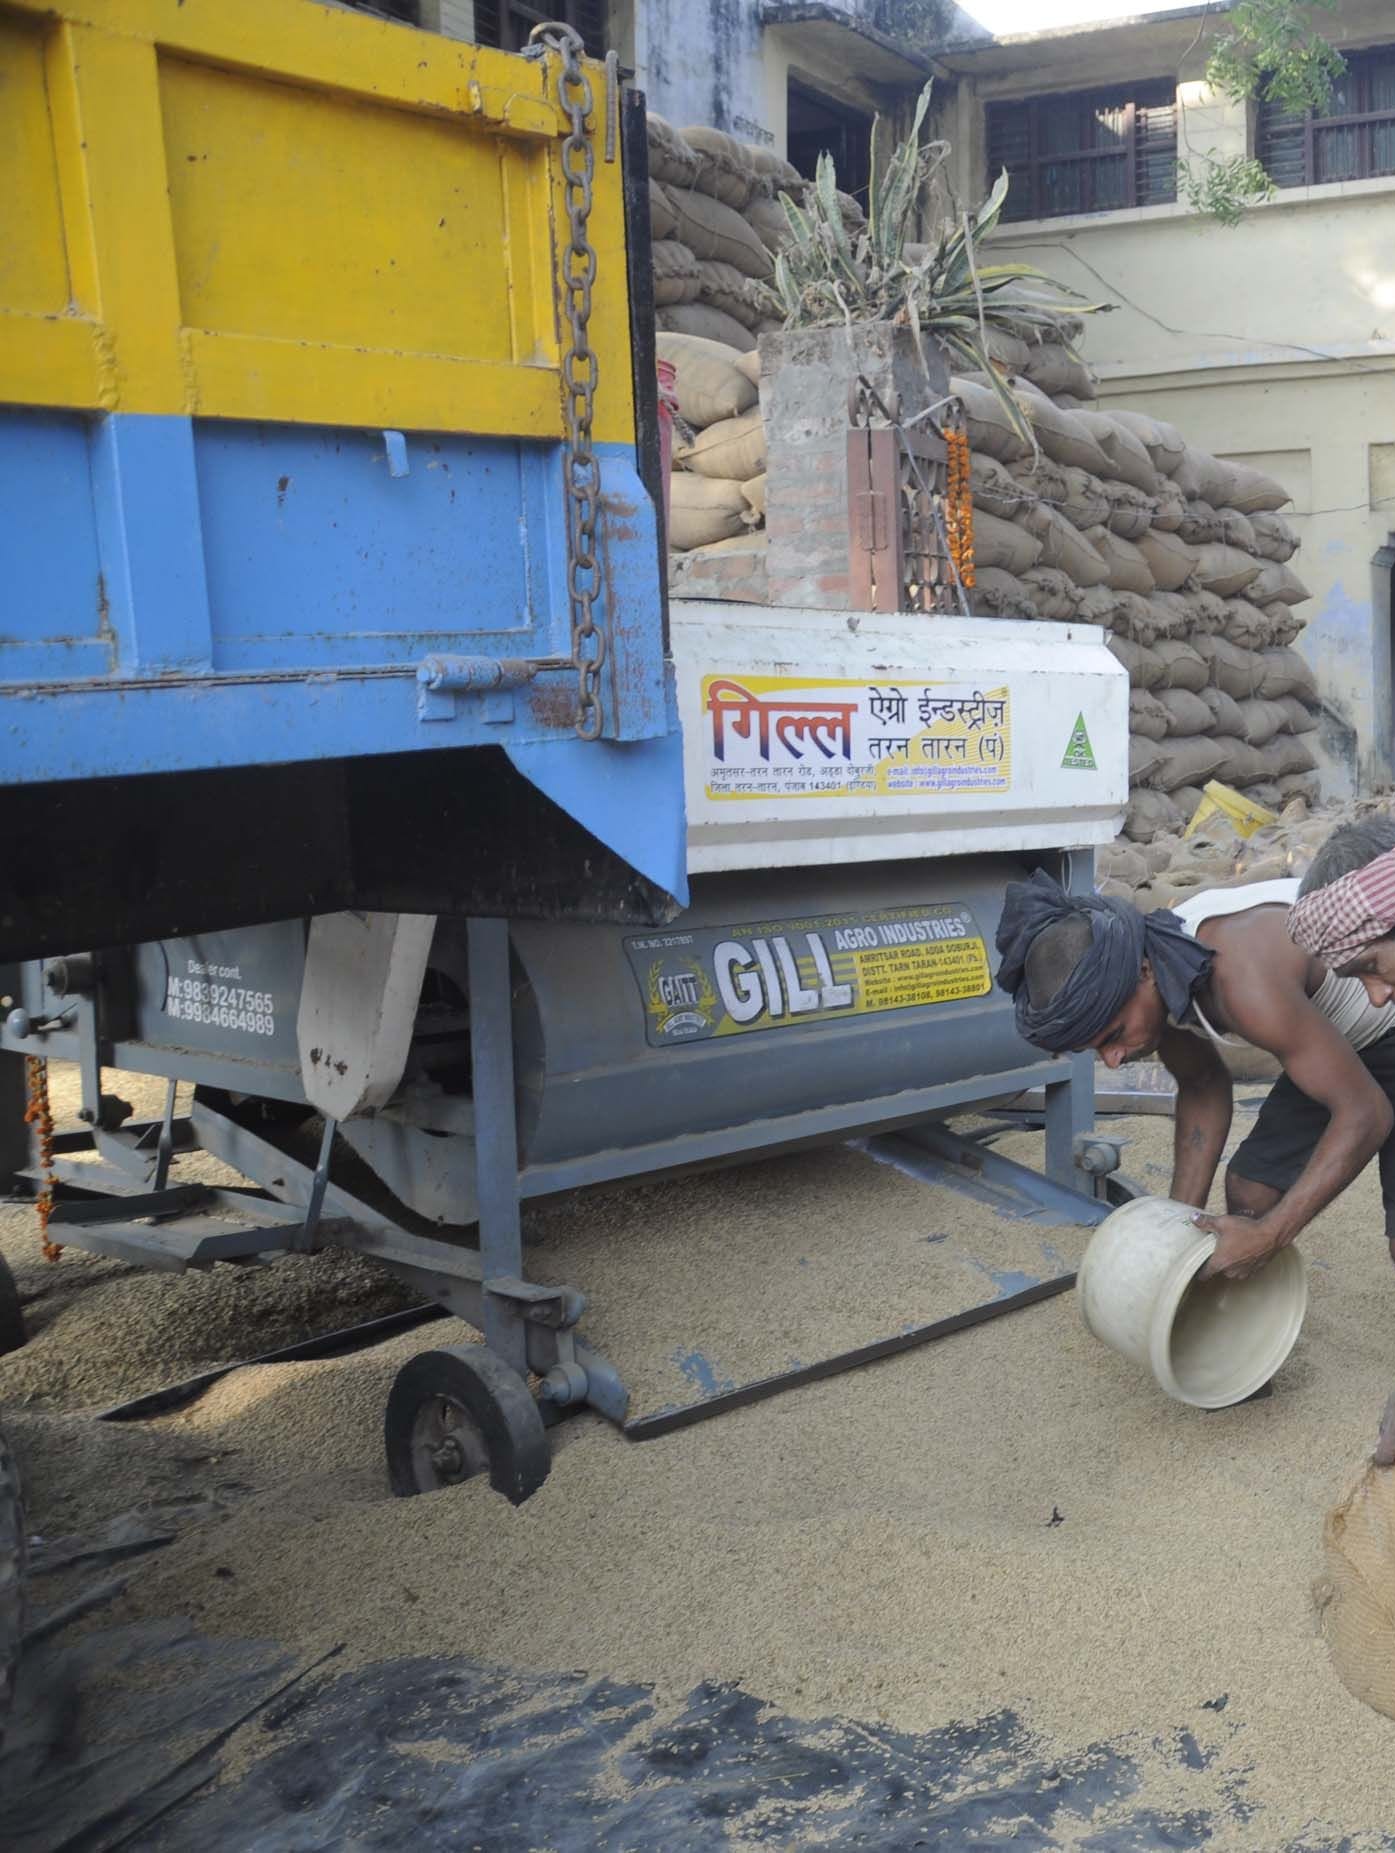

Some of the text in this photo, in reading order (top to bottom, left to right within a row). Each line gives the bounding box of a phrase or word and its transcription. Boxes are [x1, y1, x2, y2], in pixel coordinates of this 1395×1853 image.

[706, 679, 858, 763] गिल्ल
[868, 687, 1007, 730] ऐग्रो ईन्डस्ट्रीज़
[868, 732, 1005, 762] तरन तारन (पं)
[834, 917, 967, 952] AGRO INDUSTRIES
[187, 959, 218, 977] Deaer
[712, 932, 855, 1024] GILL
[890, 960, 911, 974] TARN
[167, 975, 273, 1015] M:9839247565
